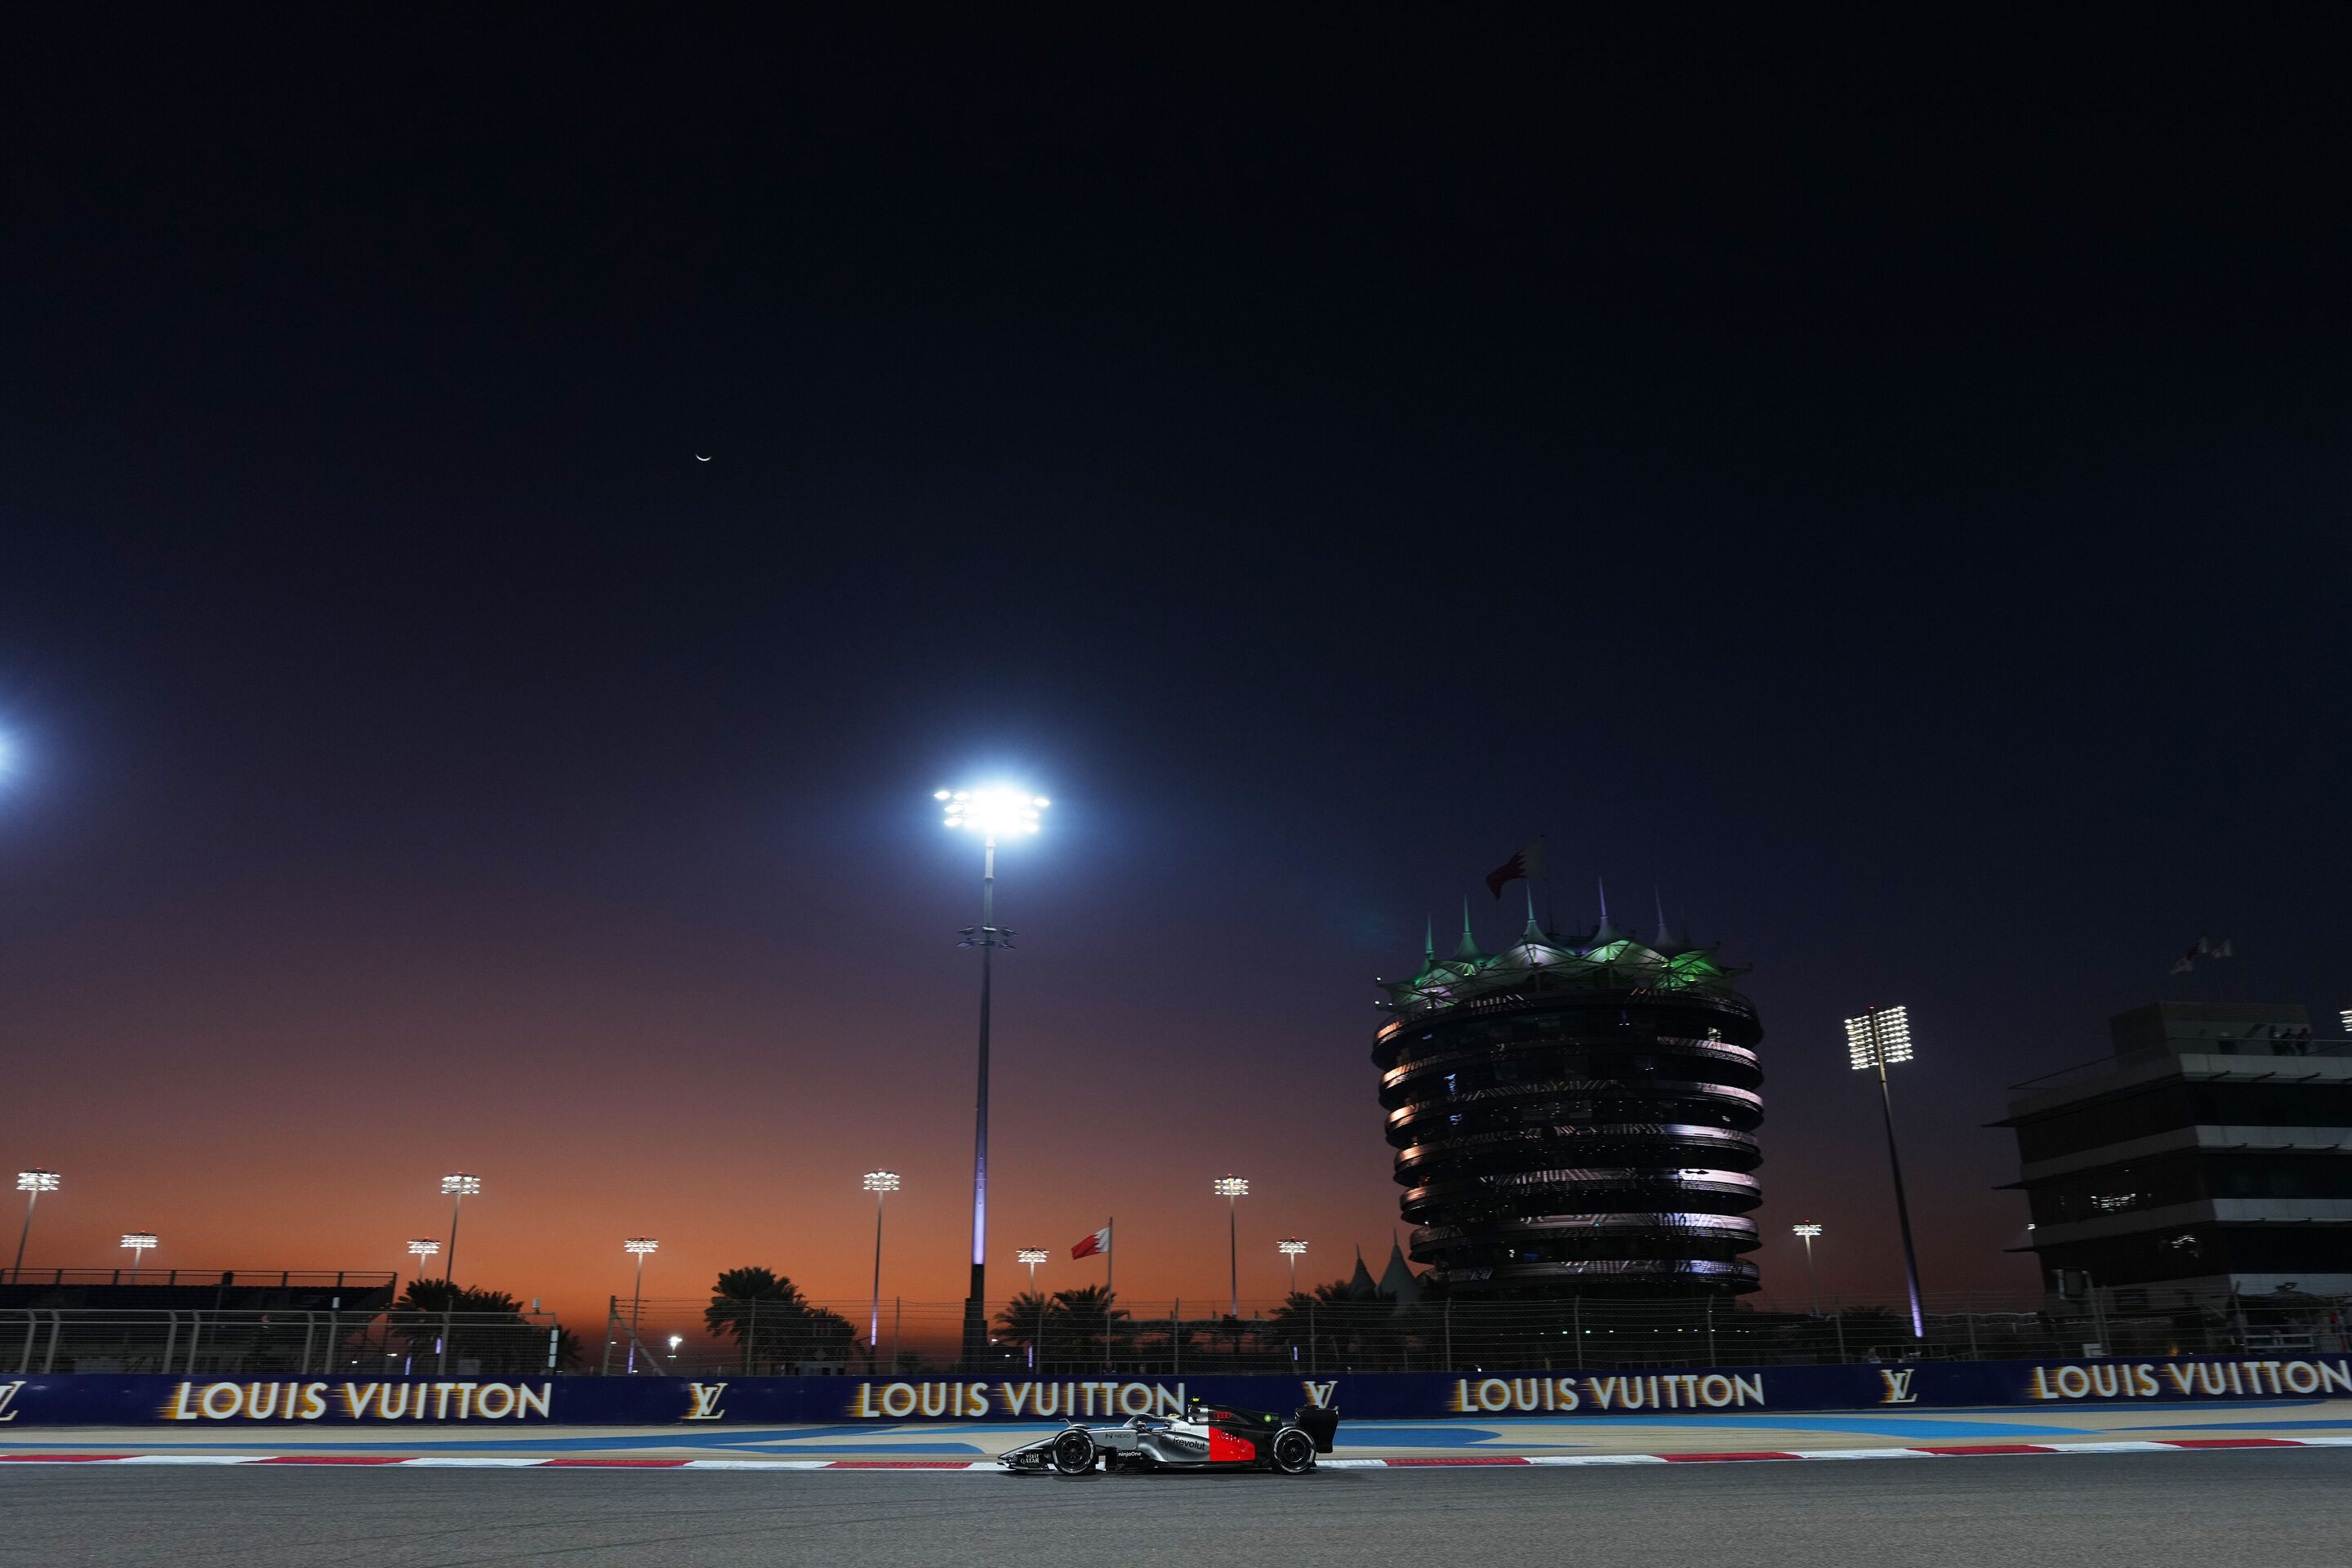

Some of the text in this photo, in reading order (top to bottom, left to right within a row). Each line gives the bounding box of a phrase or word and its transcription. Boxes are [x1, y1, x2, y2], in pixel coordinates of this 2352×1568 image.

[1460, 1374, 1765, 1412] LOUIS VUITTON
[2036, 1360, 2352, 1399] LOUIS VUITTON
[176, 1382, 552, 1419] LOUIS VUITTON
[862, 1382, 1185, 1417] LOUIS VUITTON
[1173, 1437, 1206, 1451] Revolut
